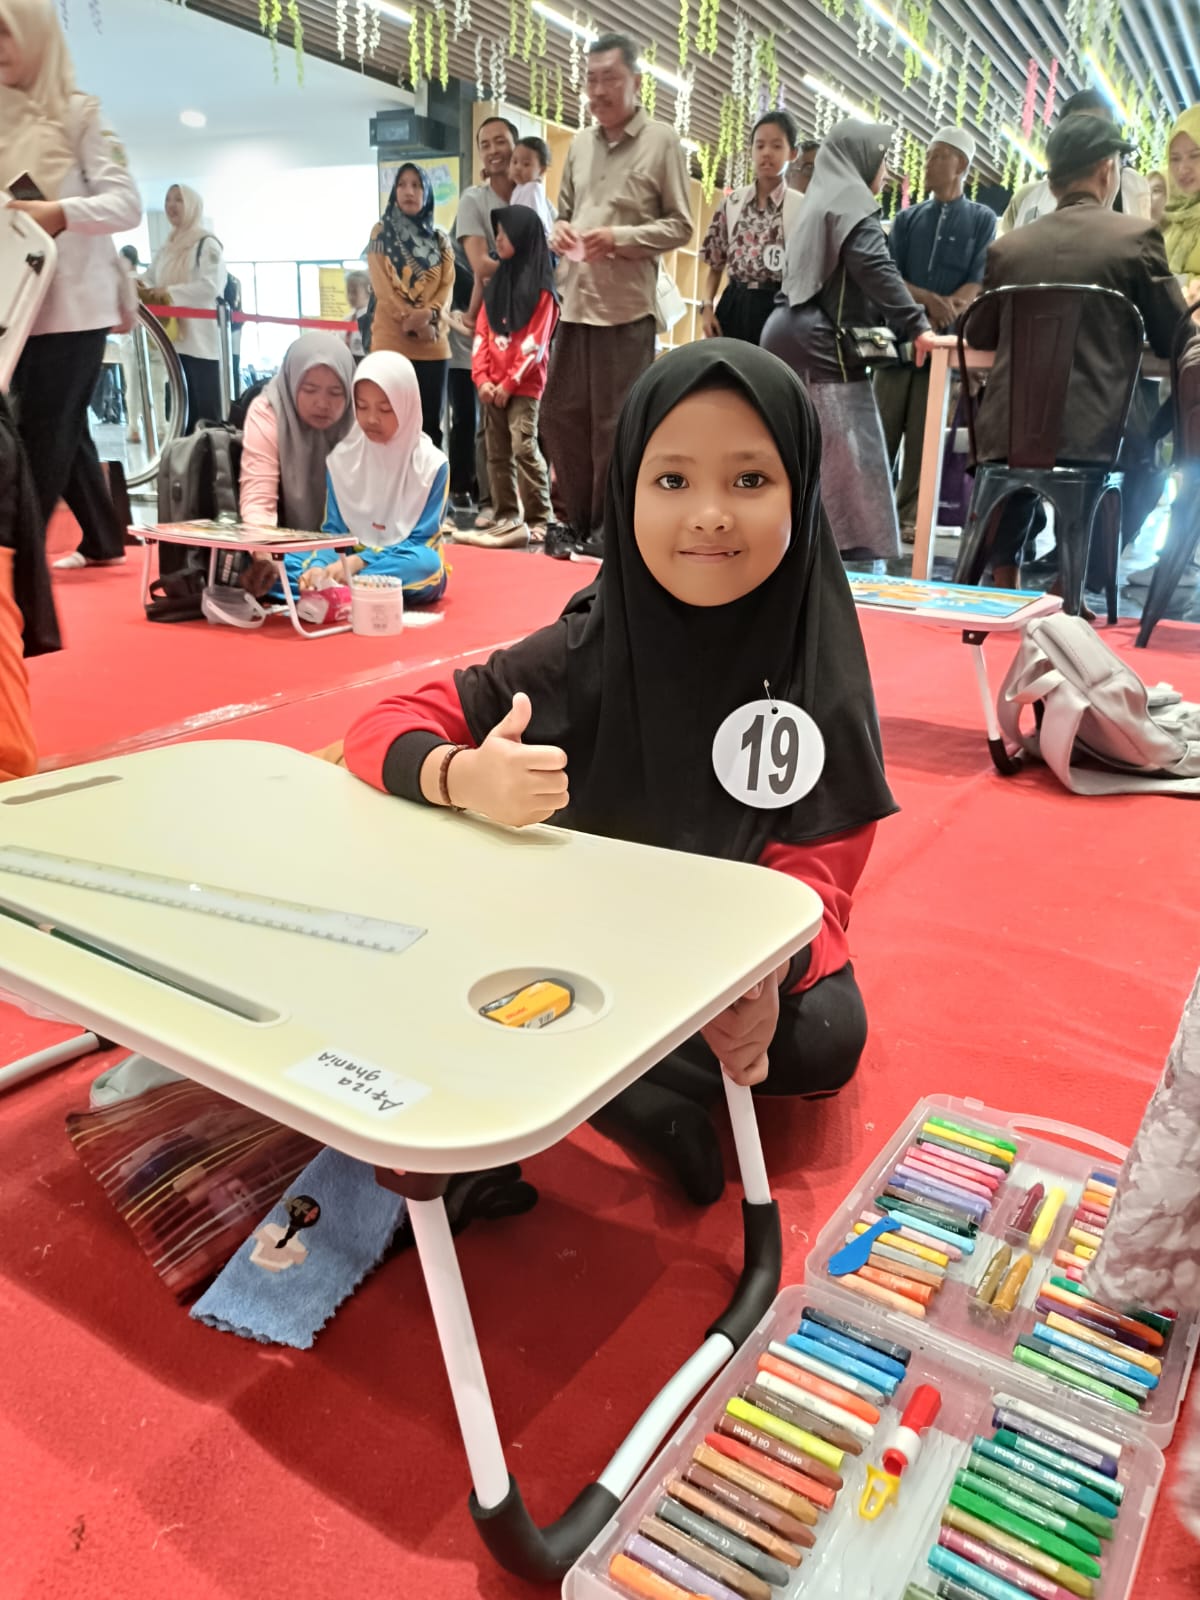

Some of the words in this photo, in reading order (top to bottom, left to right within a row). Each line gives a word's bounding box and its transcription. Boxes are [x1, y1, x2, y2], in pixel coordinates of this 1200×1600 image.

[768, 248, 781, 267] 15
[741, 714, 800, 795] 19
[732, 1424, 758, 1442] Pastel
[758, 1436, 770, 1449] Oil
[994, 1446, 1021, 1465] Pastel
